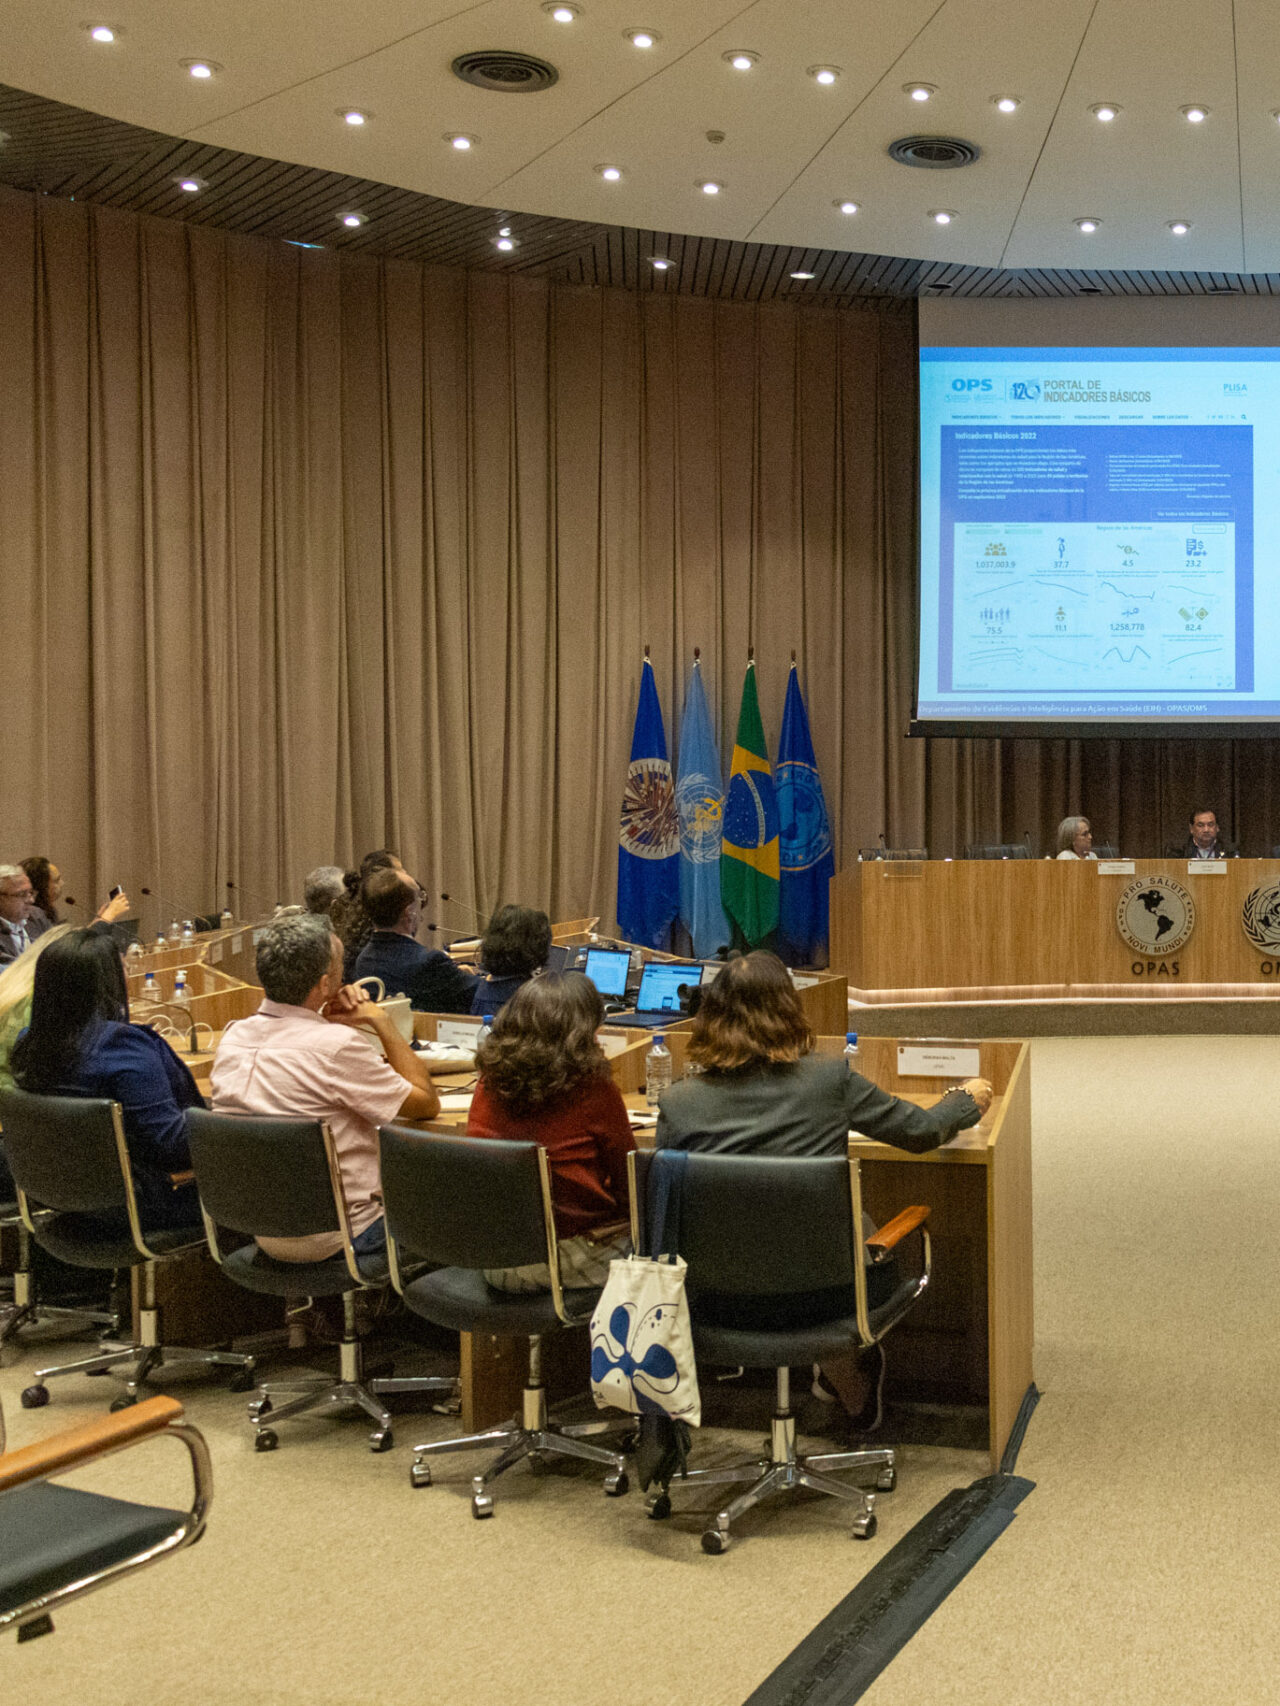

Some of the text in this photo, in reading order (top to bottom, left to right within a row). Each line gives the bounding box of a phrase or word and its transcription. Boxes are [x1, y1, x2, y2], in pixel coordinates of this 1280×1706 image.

[951, 379, 993, 391] OPS
[1043, 380, 1102, 390] PORTAL DE
[1223, 383, 1247, 392] PLISA
[1043, 389, 1151, 403] INDICADORES BÁSICOS
[955, 432, 993, 440] Indicadores
[993, 432, 1019, 440] Básicos
[1070, 706, 1087, 714] para
[1088, 705, 1105, 714] Ação
[1120, 704, 1142, 712] Saúde
[1167, 704, 1208, 713] OPAS/OMS
[1123, 877, 1189, 900] PRO SALUTE
[1127, 936, 1185, 953] NOVI MUNDI
[1131, 961, 1180, 976] OPAS
